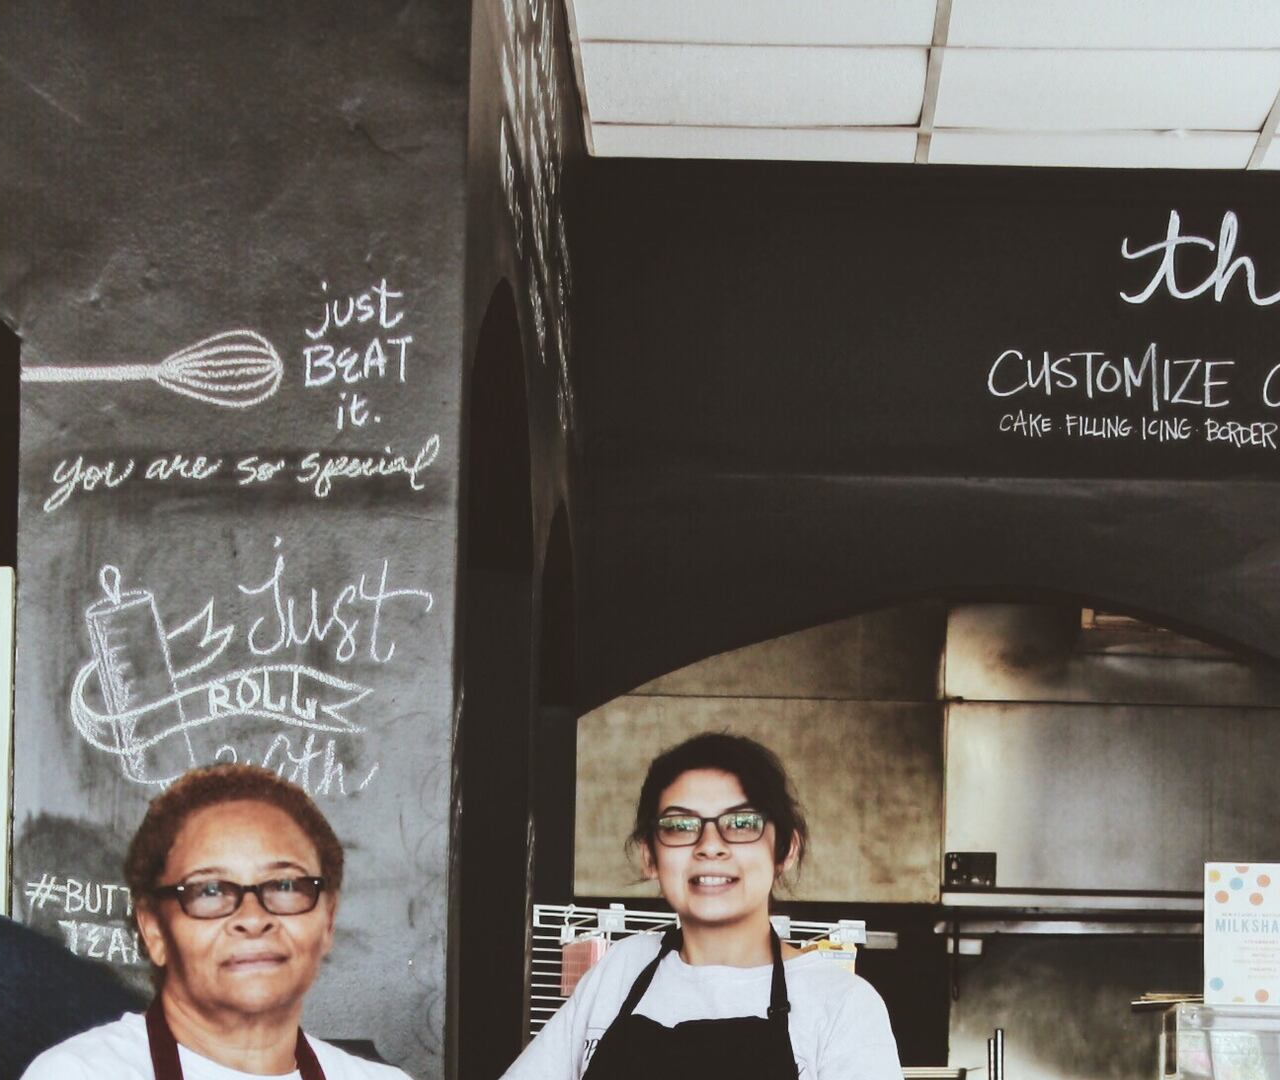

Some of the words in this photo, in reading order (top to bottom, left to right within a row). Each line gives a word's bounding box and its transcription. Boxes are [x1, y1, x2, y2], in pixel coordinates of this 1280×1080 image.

[305, 278, 404, 339] just
[987, 343, 1235, 412] CUSTOMIZE
[999, 410, 1051, 437] CAKE
[1066, 415, 1132, 438] FILLING
[1142, 417, 1191, 441] ICING
[1206, 418, 1277, 449] BORDER
[43, 455, 135, 511] you
[145, 452, 223, 480] are
[238, 453, 286, 485] so
[297, 435, 441, 497] special
[208, 670, 317, 721] ROLL
[25, 873, 133, 916] #BUTT
